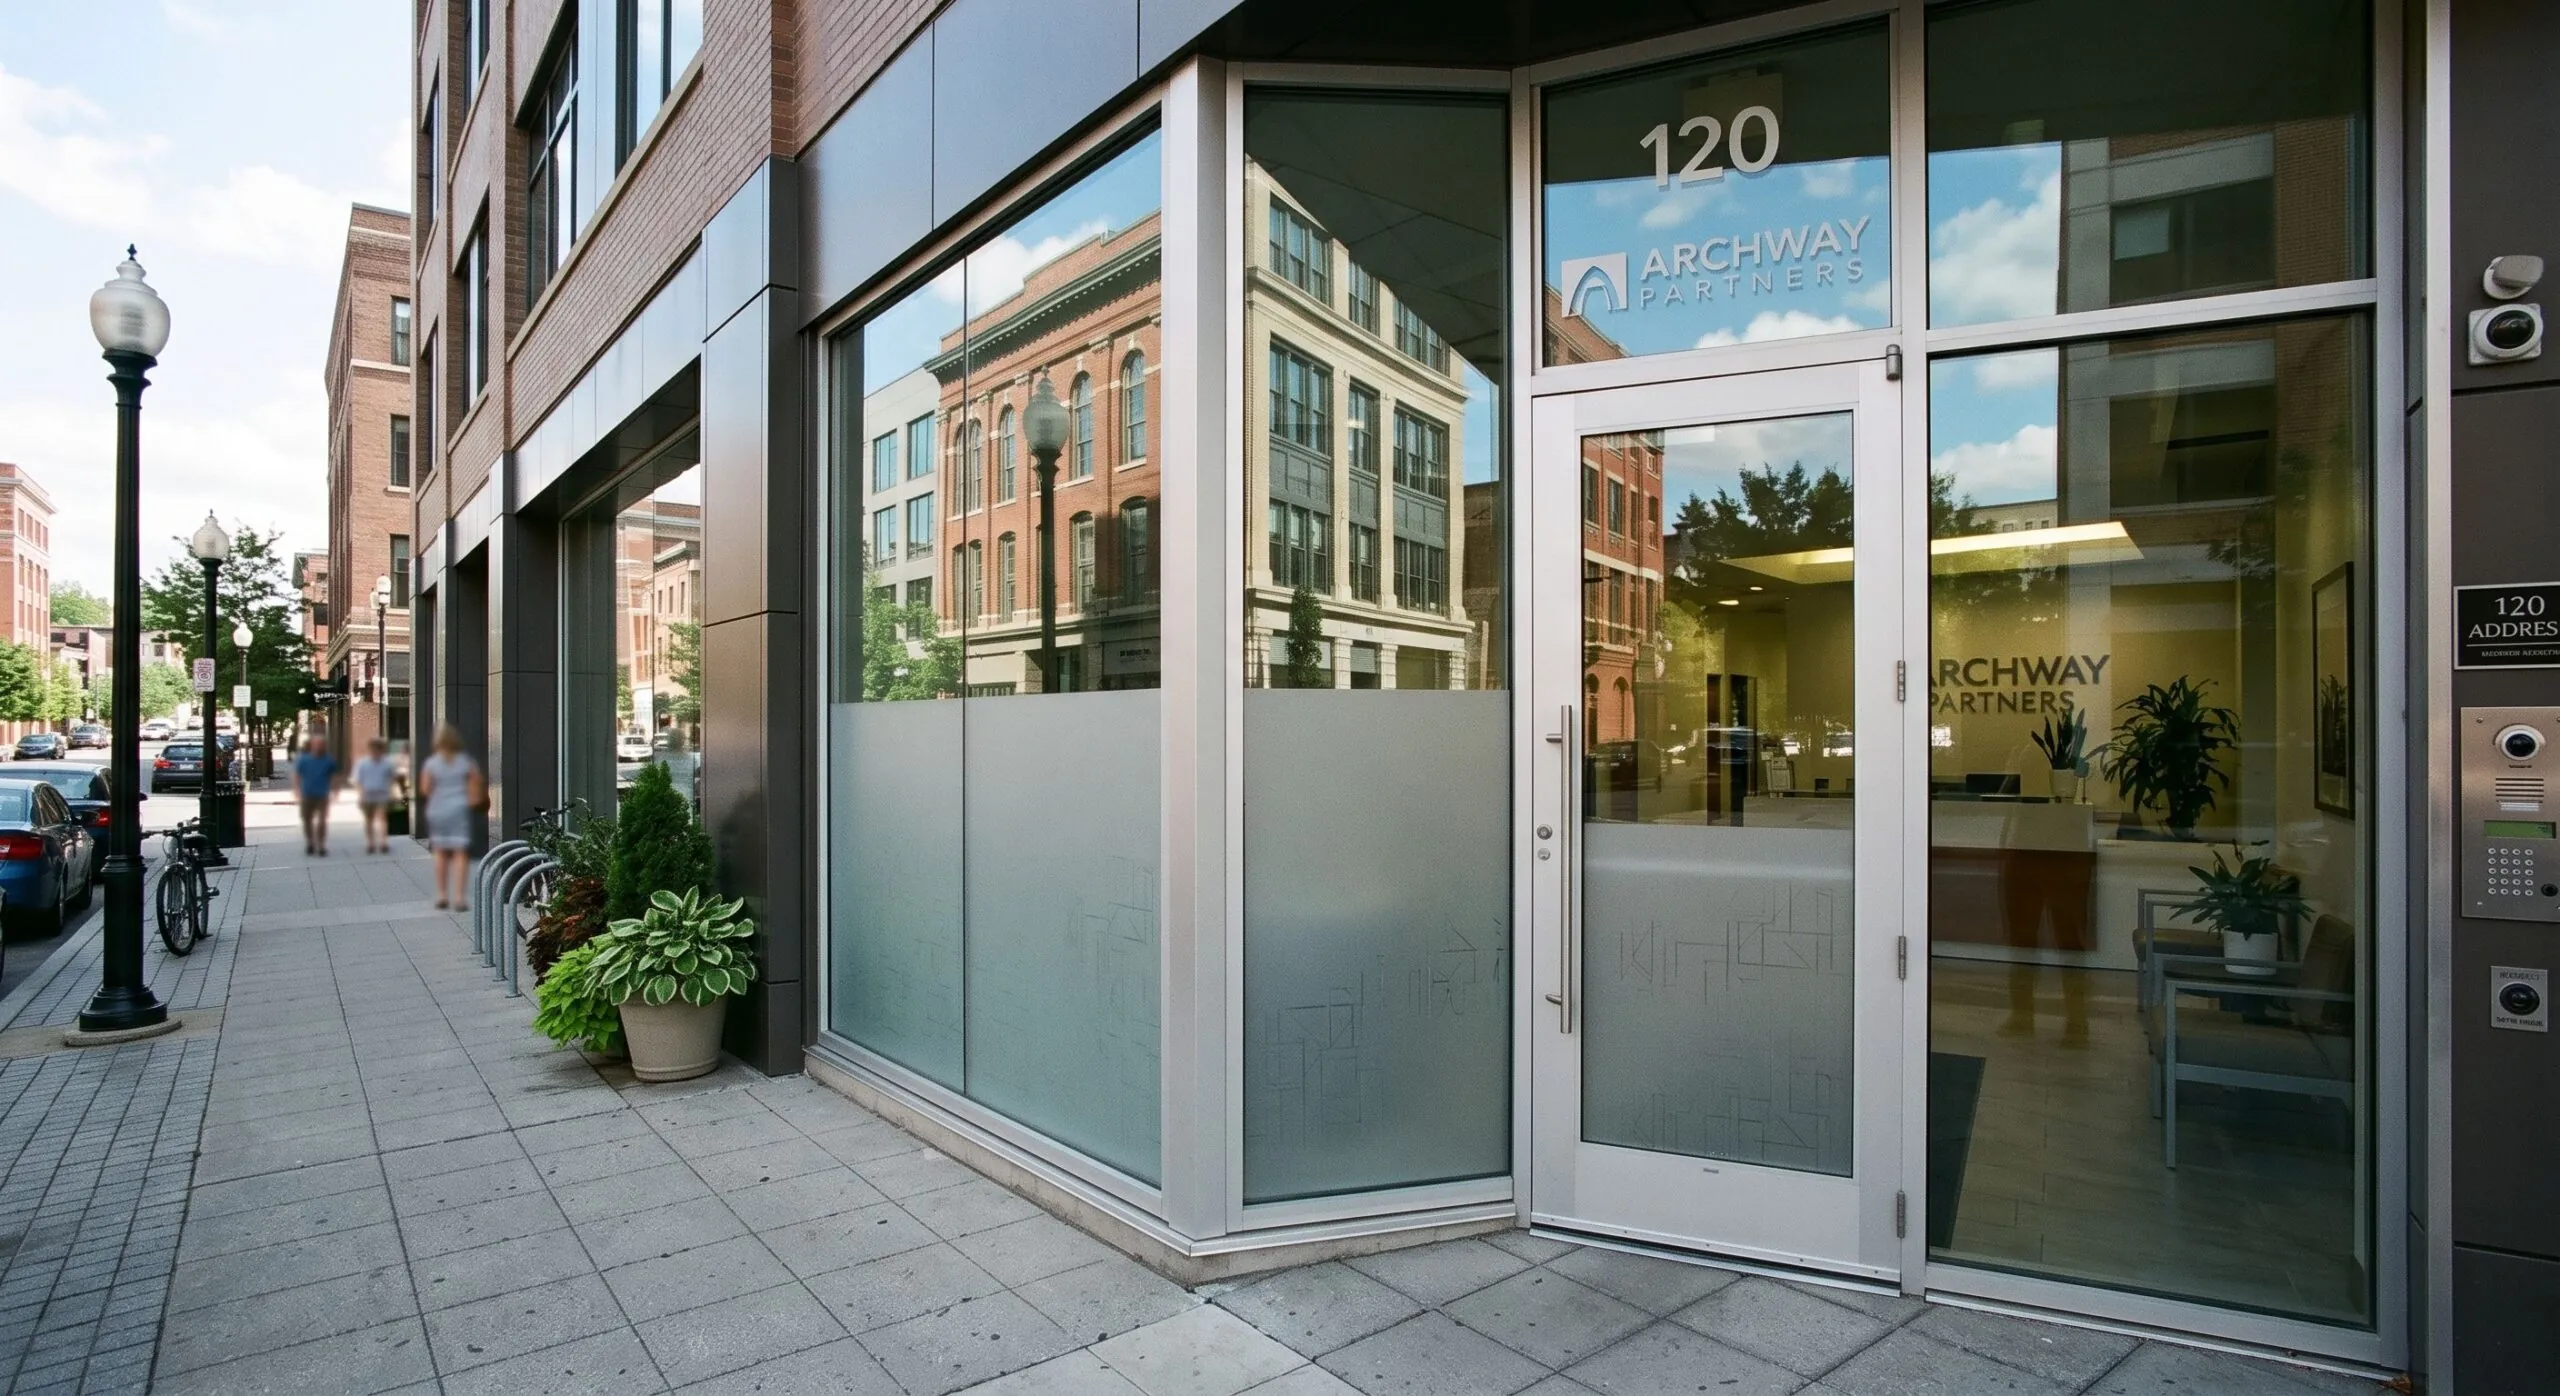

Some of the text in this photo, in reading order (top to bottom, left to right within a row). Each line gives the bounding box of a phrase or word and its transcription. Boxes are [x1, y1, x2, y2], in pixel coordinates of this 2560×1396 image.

[1639, 106, 1780, 187] 120
[1640, 215, 1871, 280] ARCHWAY
[1641, 258, 1864, 308] PARTNERS
[2494, 595, 2545, 616] 120
[1931, 655, 2110, 687] RCHWAY
